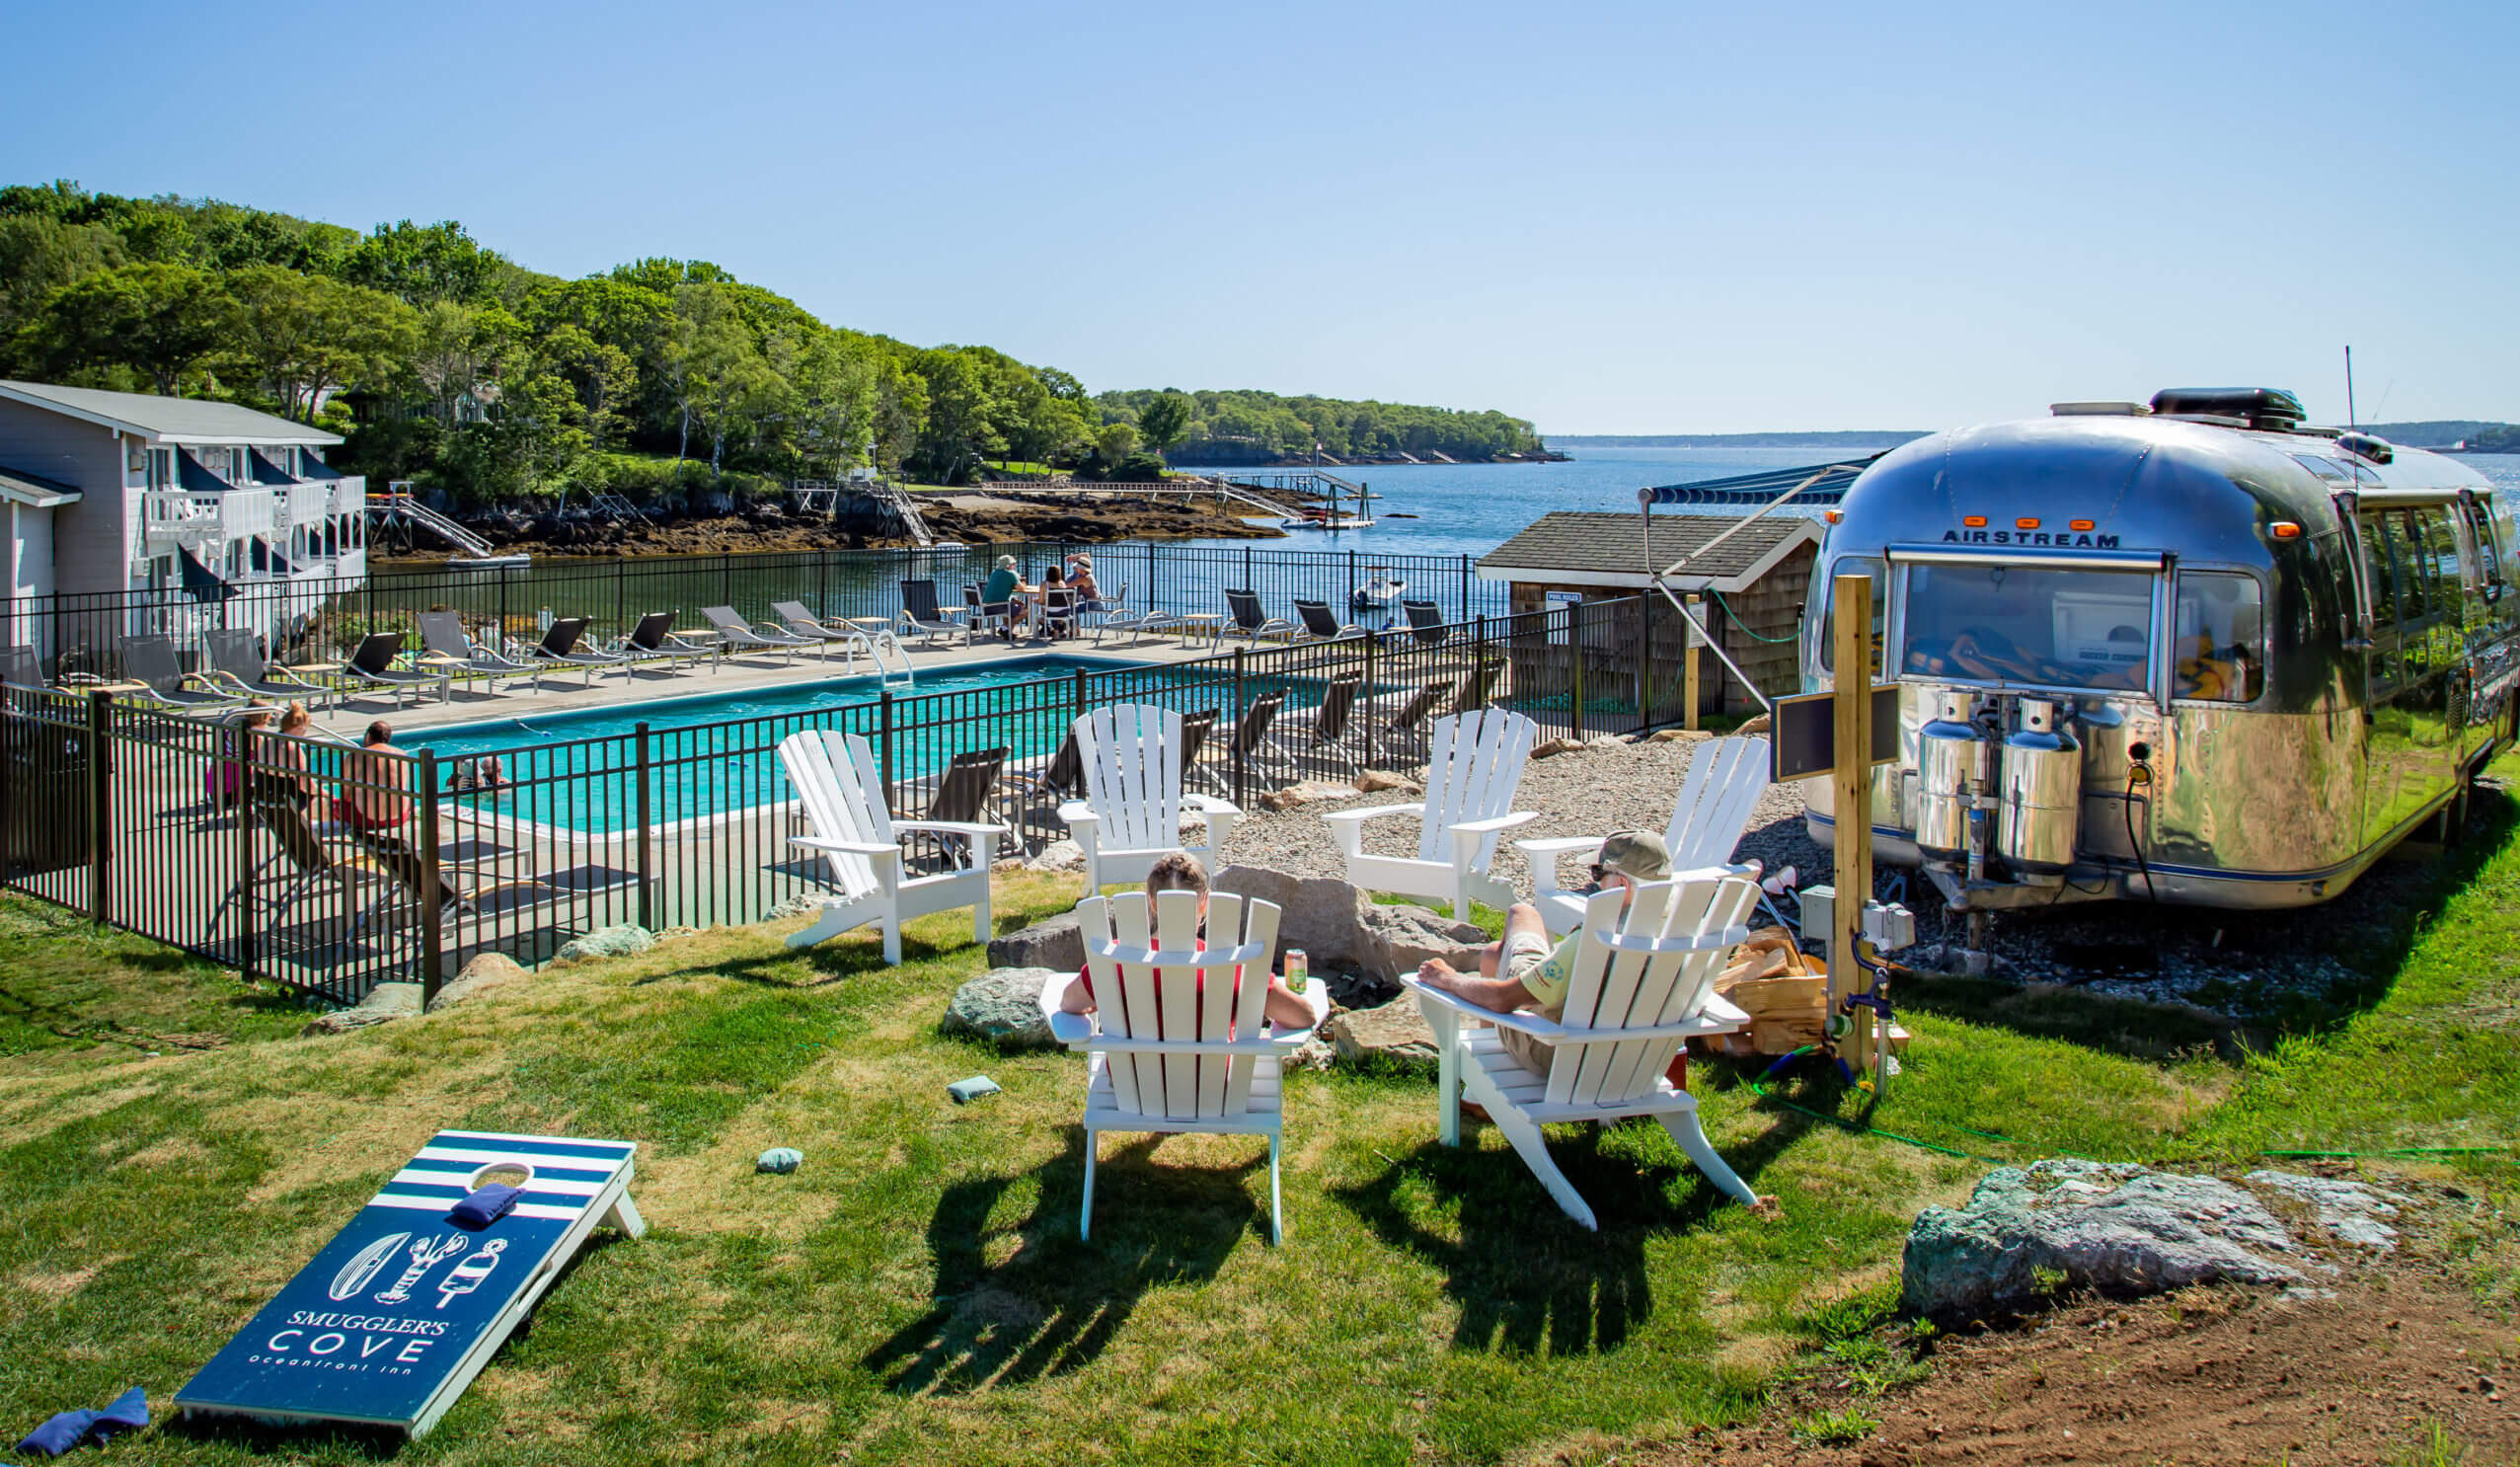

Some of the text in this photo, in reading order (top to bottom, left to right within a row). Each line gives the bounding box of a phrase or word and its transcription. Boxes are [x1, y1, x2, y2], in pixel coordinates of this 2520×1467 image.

[1944, 530, 2119, 548] AIRSTREAM
[286, 1310, 449, 1336] SMUGGLER'S
[267, 1329, 433, 1361] COVE
